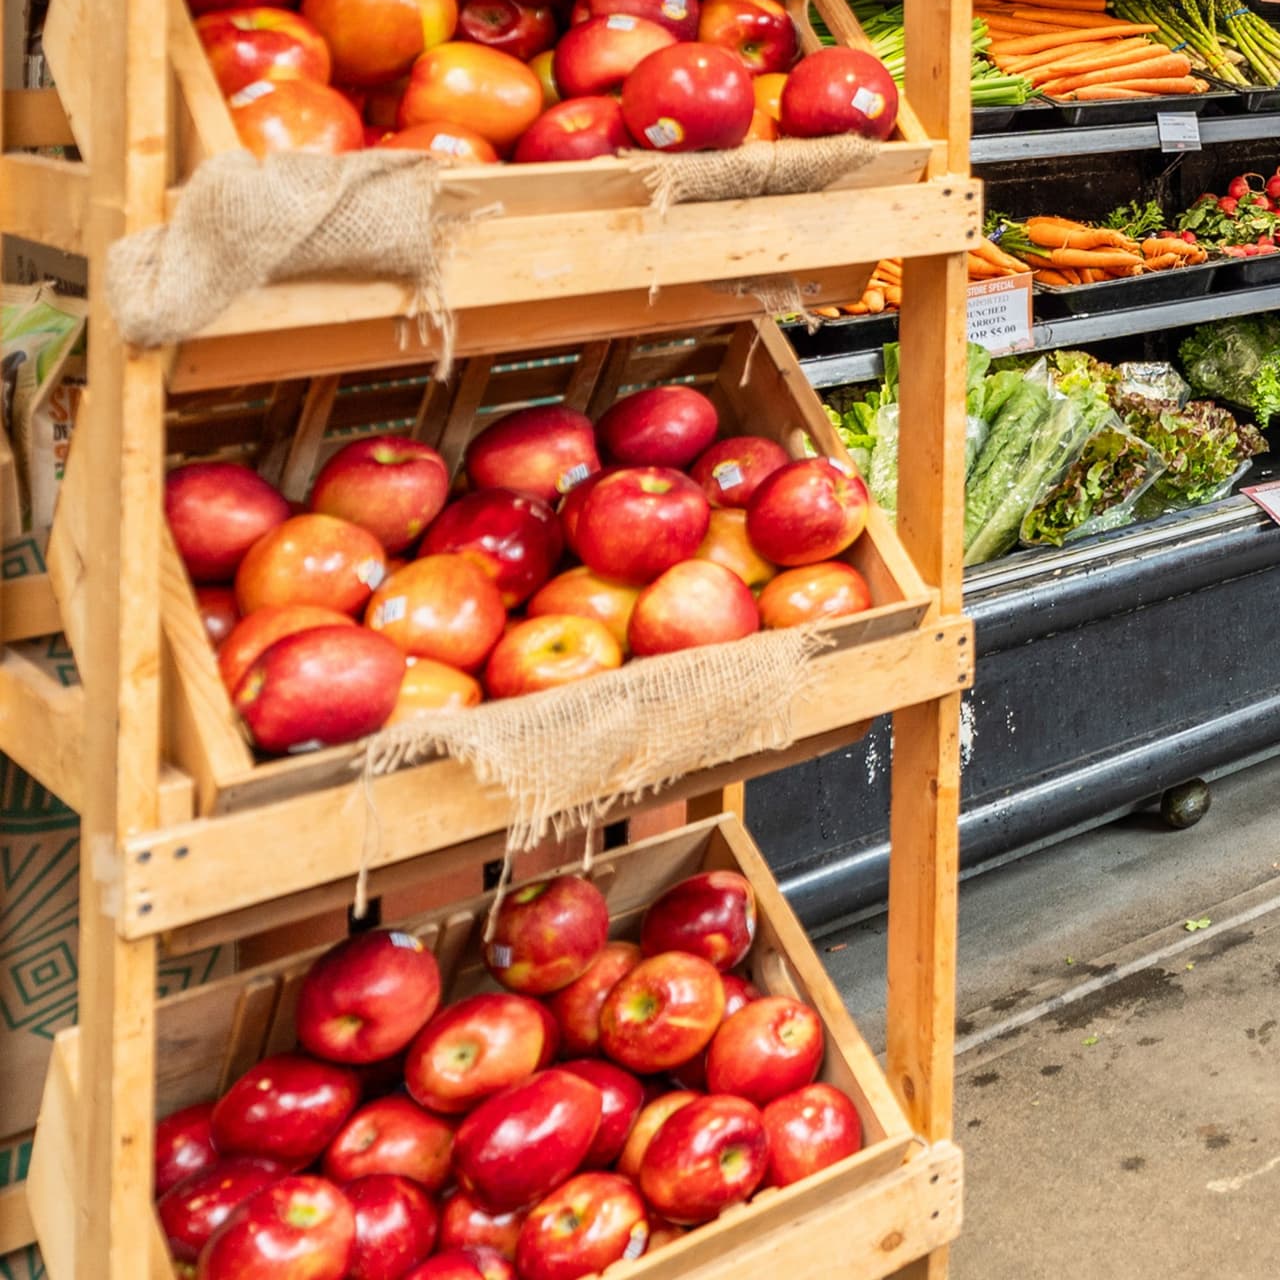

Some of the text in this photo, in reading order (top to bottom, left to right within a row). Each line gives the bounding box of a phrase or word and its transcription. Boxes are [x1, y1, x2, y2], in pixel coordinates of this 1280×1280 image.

[988, 279, 1016, 293] SPECIAL
[970, 324, 1017, 340] OR $5.00
